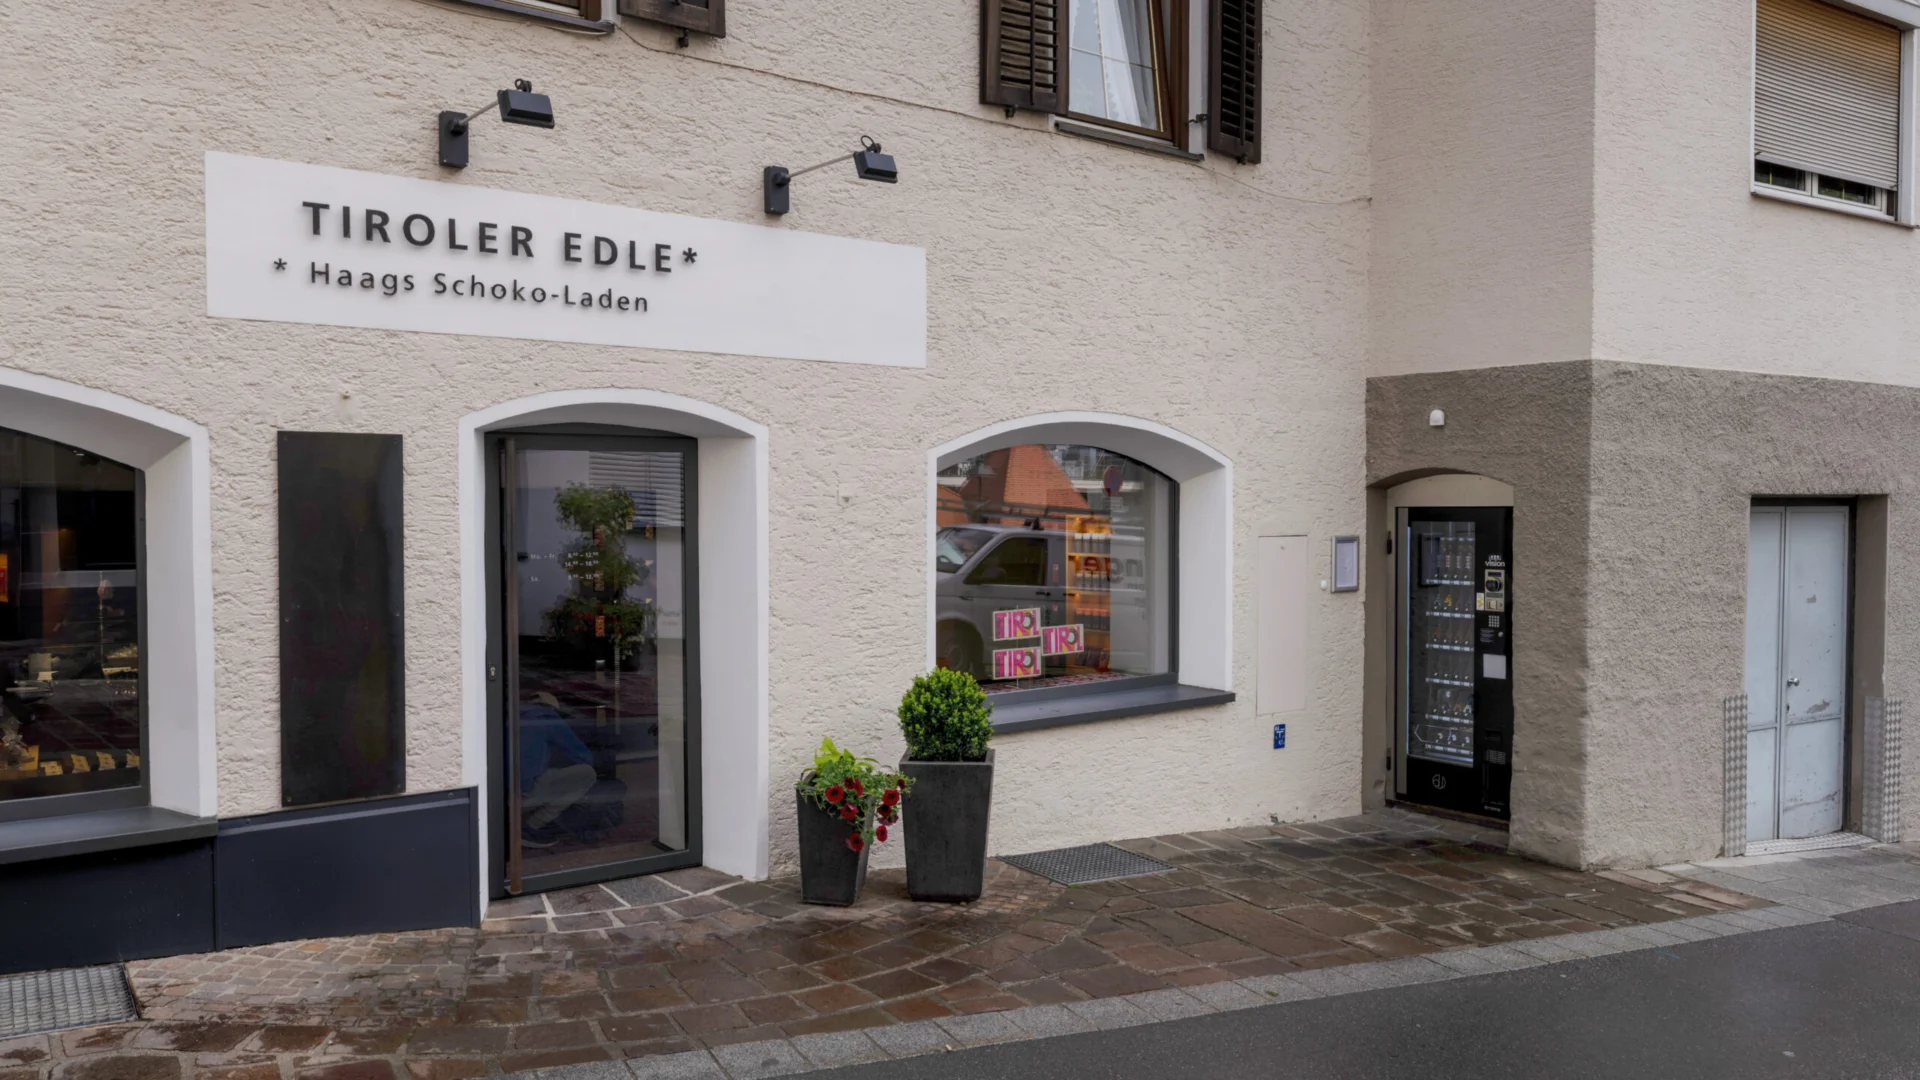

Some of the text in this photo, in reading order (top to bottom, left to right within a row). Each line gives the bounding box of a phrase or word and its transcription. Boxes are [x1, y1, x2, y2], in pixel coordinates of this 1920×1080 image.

[302, 201, 534, 258] TIROLER
[311, 261, 415, 295] Haags
[433, 272, 649, 312] Schoko-Laden
[1484, 560, 1506, 568] vision
[995, 609, 1040, 639] TIROL
[1042, 625, 1083, 654] TIROL
[995, 648, 1040, 678] TIROL
